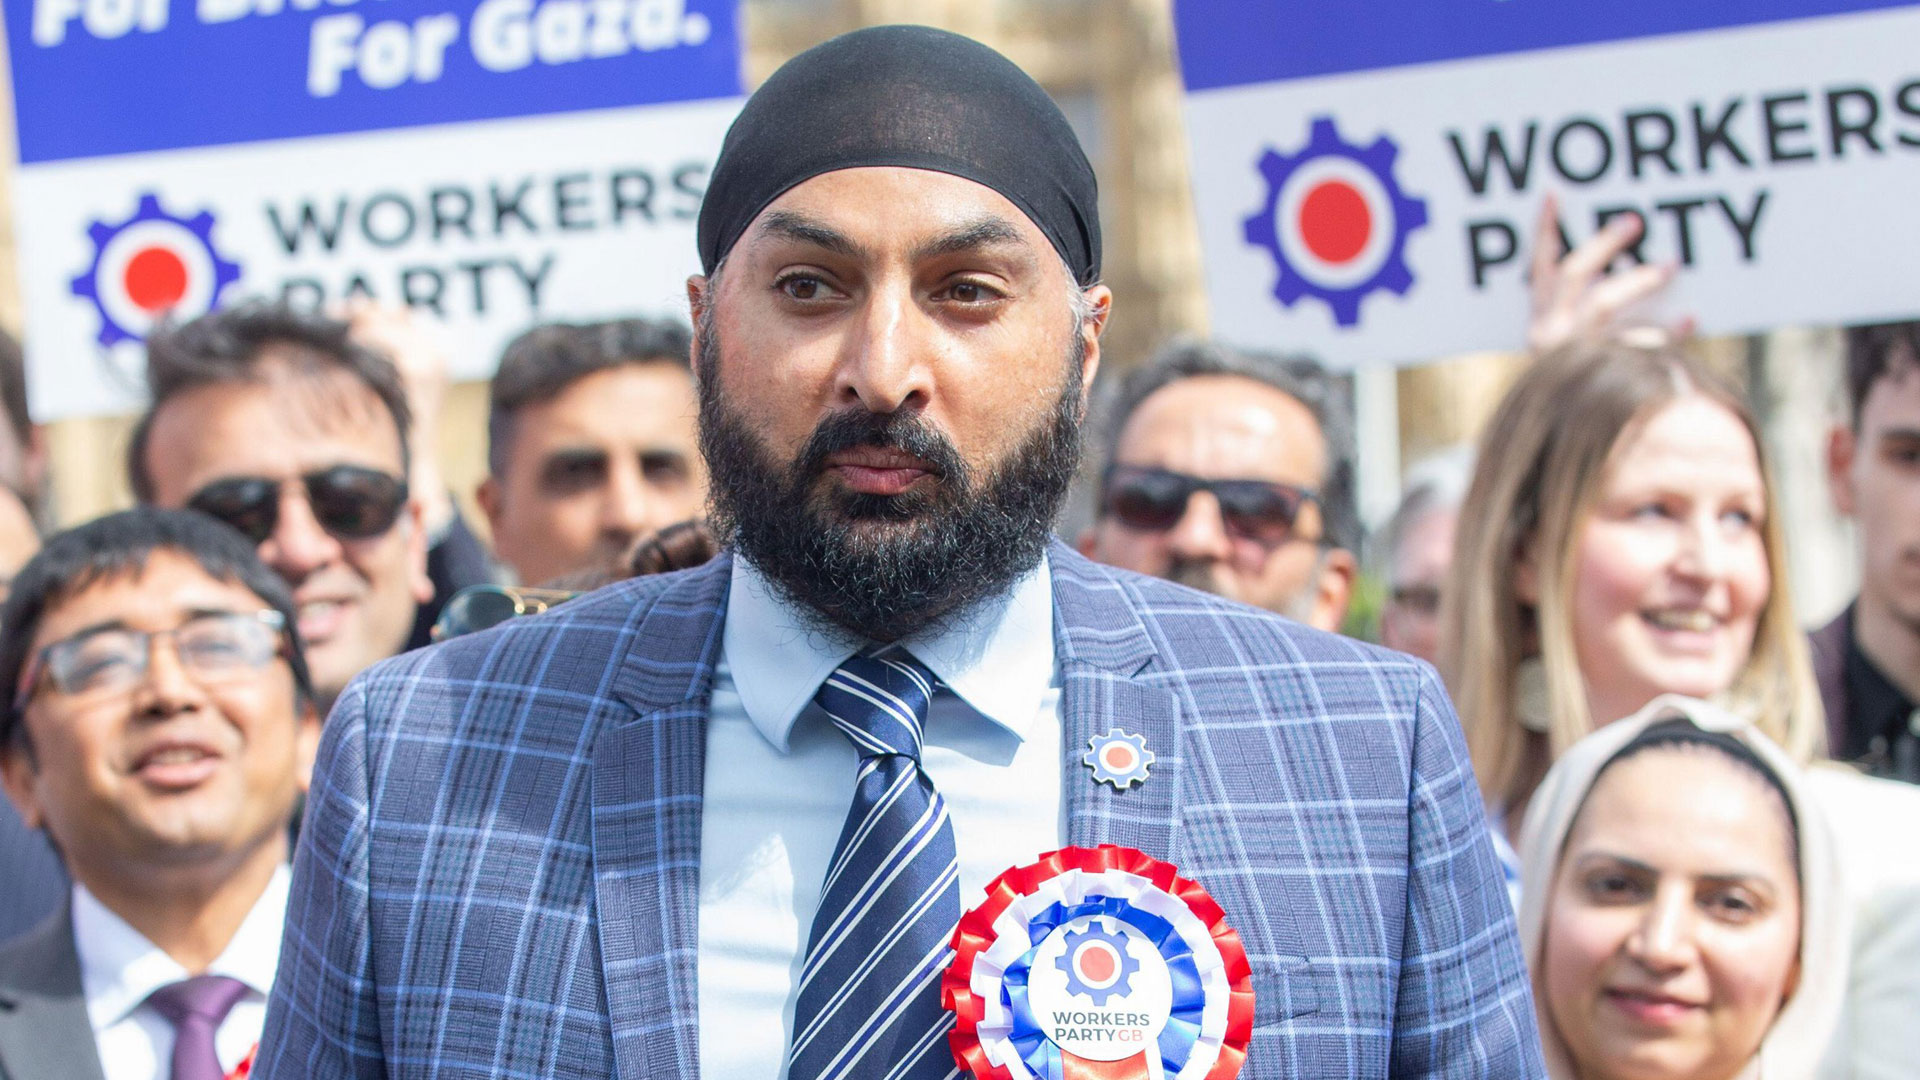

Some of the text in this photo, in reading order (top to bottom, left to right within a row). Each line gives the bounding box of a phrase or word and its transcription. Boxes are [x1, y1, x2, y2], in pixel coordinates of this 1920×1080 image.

[306, 0, 711, 98] For Gaza.
[267, 165, 706, 254] WORKERS
[1052, 1011, 1150, 1026] WORKERS
